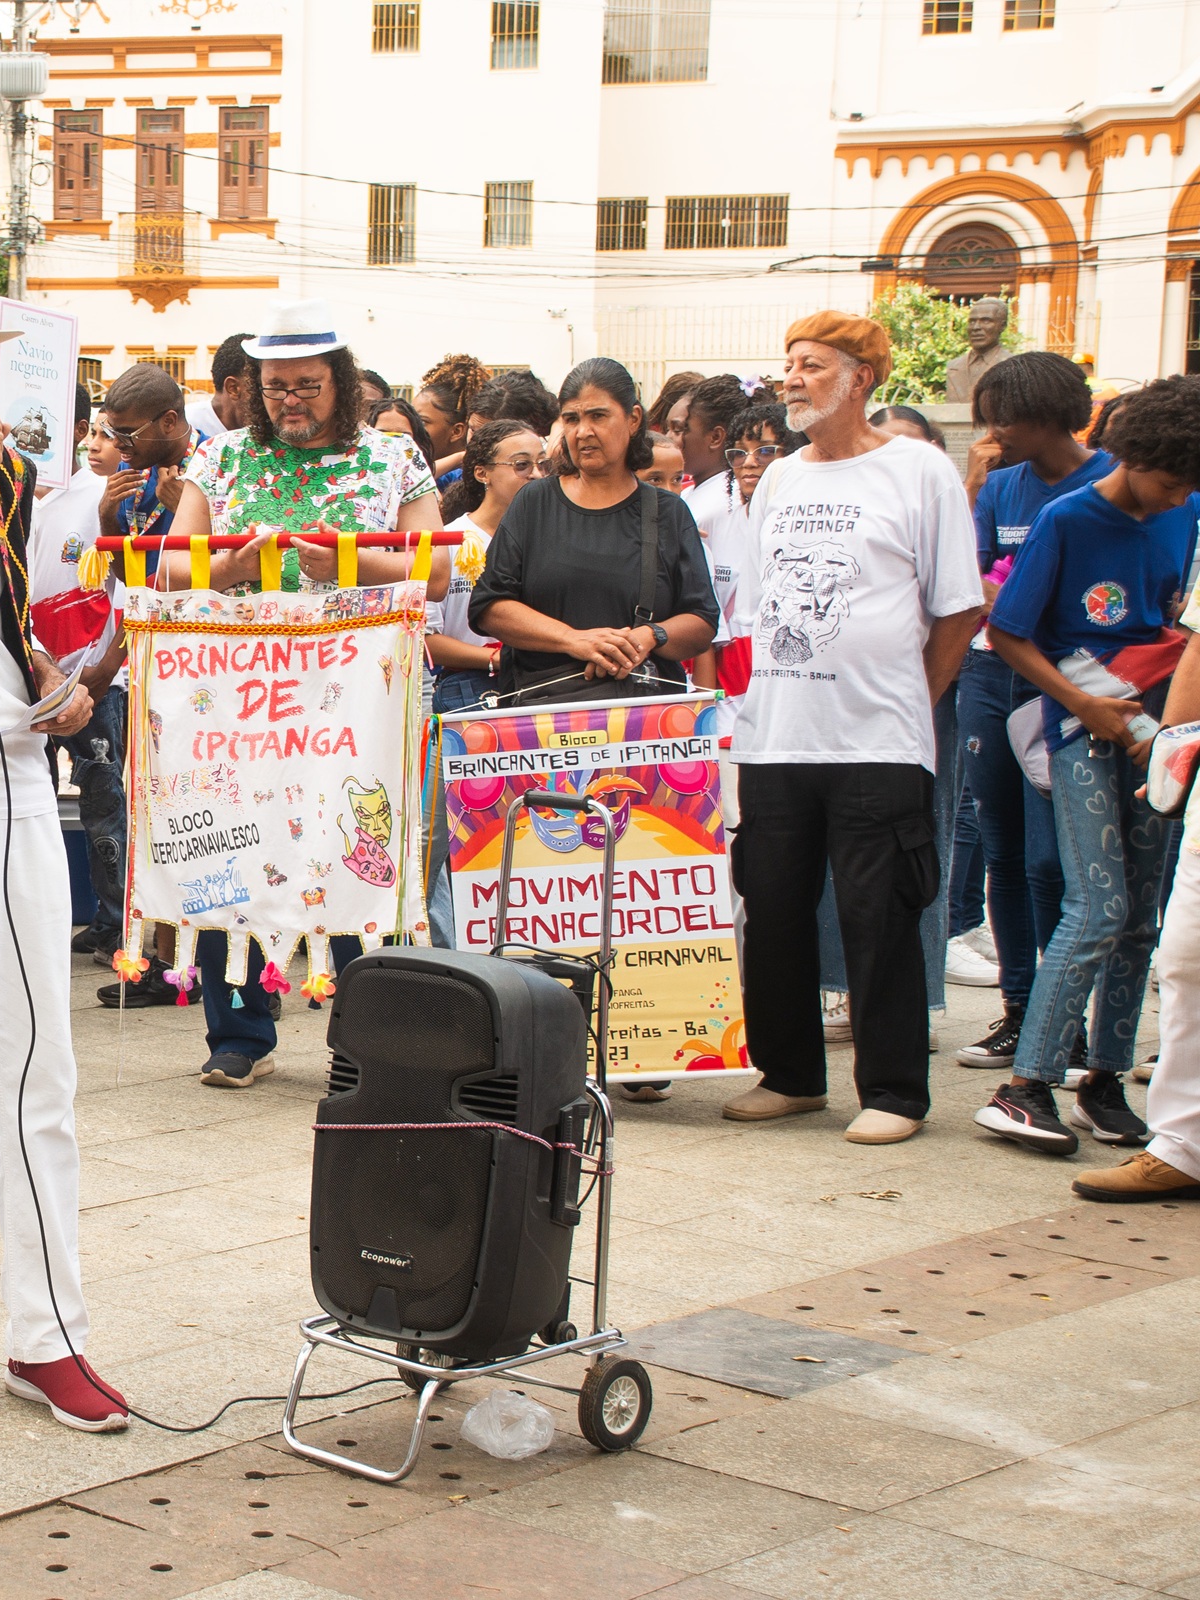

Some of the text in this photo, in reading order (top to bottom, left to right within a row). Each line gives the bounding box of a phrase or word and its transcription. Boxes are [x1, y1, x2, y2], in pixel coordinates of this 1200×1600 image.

[18, 339, 54, 362] Navio
[10, 360, 59, 380] negreiro
[789, 520, 855, 534] IPITANGA
[771, 669, 800, 679] FREITAS
[809, 671, 836, 681] BAHIA
[235, 679, 306, 722] DE
[559, 734, 597, 747] Bloco
[448, 739, 711, 778] BRINCANTES DE IPITANGA
[168, 809, 214, 835] BLOCO
[178, 823, 260, 862] CARNAVALESCO
[472, 864, 716, 909] MOVIMENTO
[625, 946, 732, 968] CARNAVAL
[684, 1021, 708, 1036] Ba
